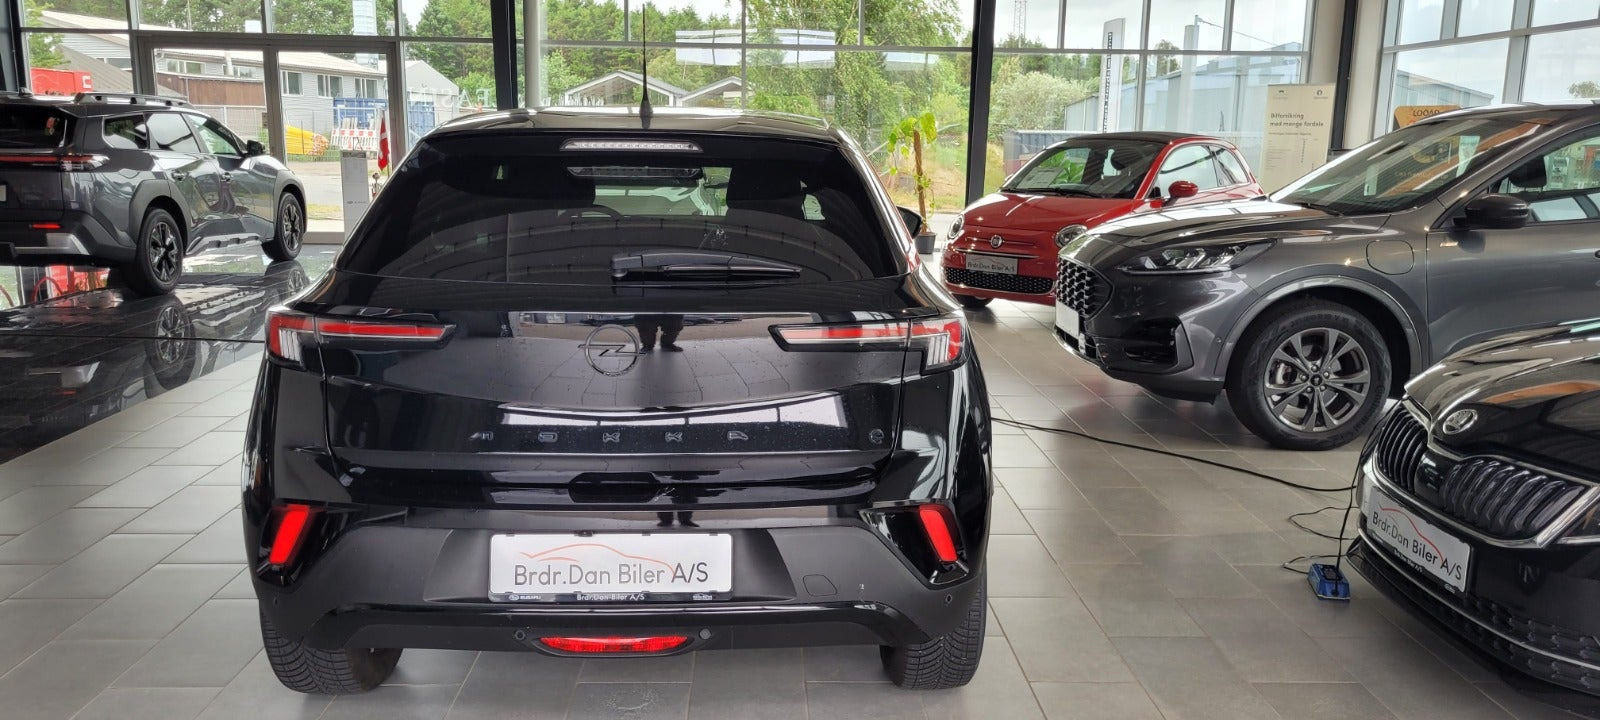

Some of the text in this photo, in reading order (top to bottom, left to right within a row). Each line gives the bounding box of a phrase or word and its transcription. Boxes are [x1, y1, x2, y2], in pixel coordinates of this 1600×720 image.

[1412, 539, 1438, 564] Biler
[1440, 557, 1462, 581] A/S
[514, 562, 709, 586] Brdr.Dan Biler A/S
[629, 593, 645, 601] A/S
